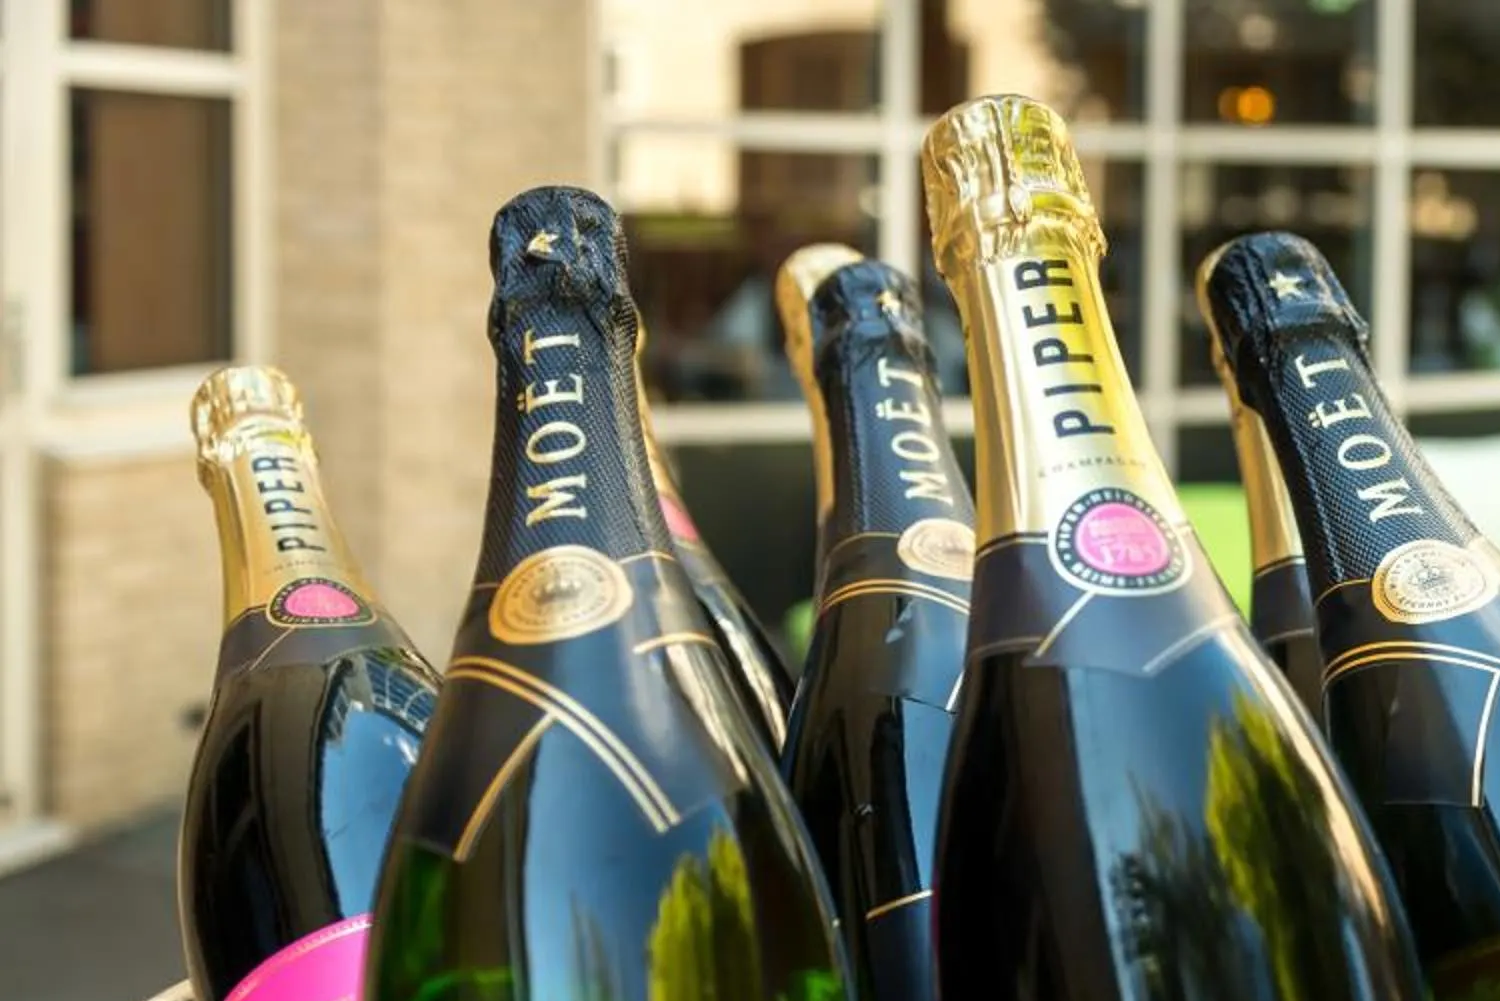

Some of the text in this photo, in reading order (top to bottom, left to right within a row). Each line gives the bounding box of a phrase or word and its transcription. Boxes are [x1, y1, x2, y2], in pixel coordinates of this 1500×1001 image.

[518, 328, 588, 528] MOËT
[877, 357, 955, 506] MOËT
[1013, 257, 1116, 439] PIPER
[250, 456, 326, 554] PIPER
[1294, 355, 1424, 524] MOËT
